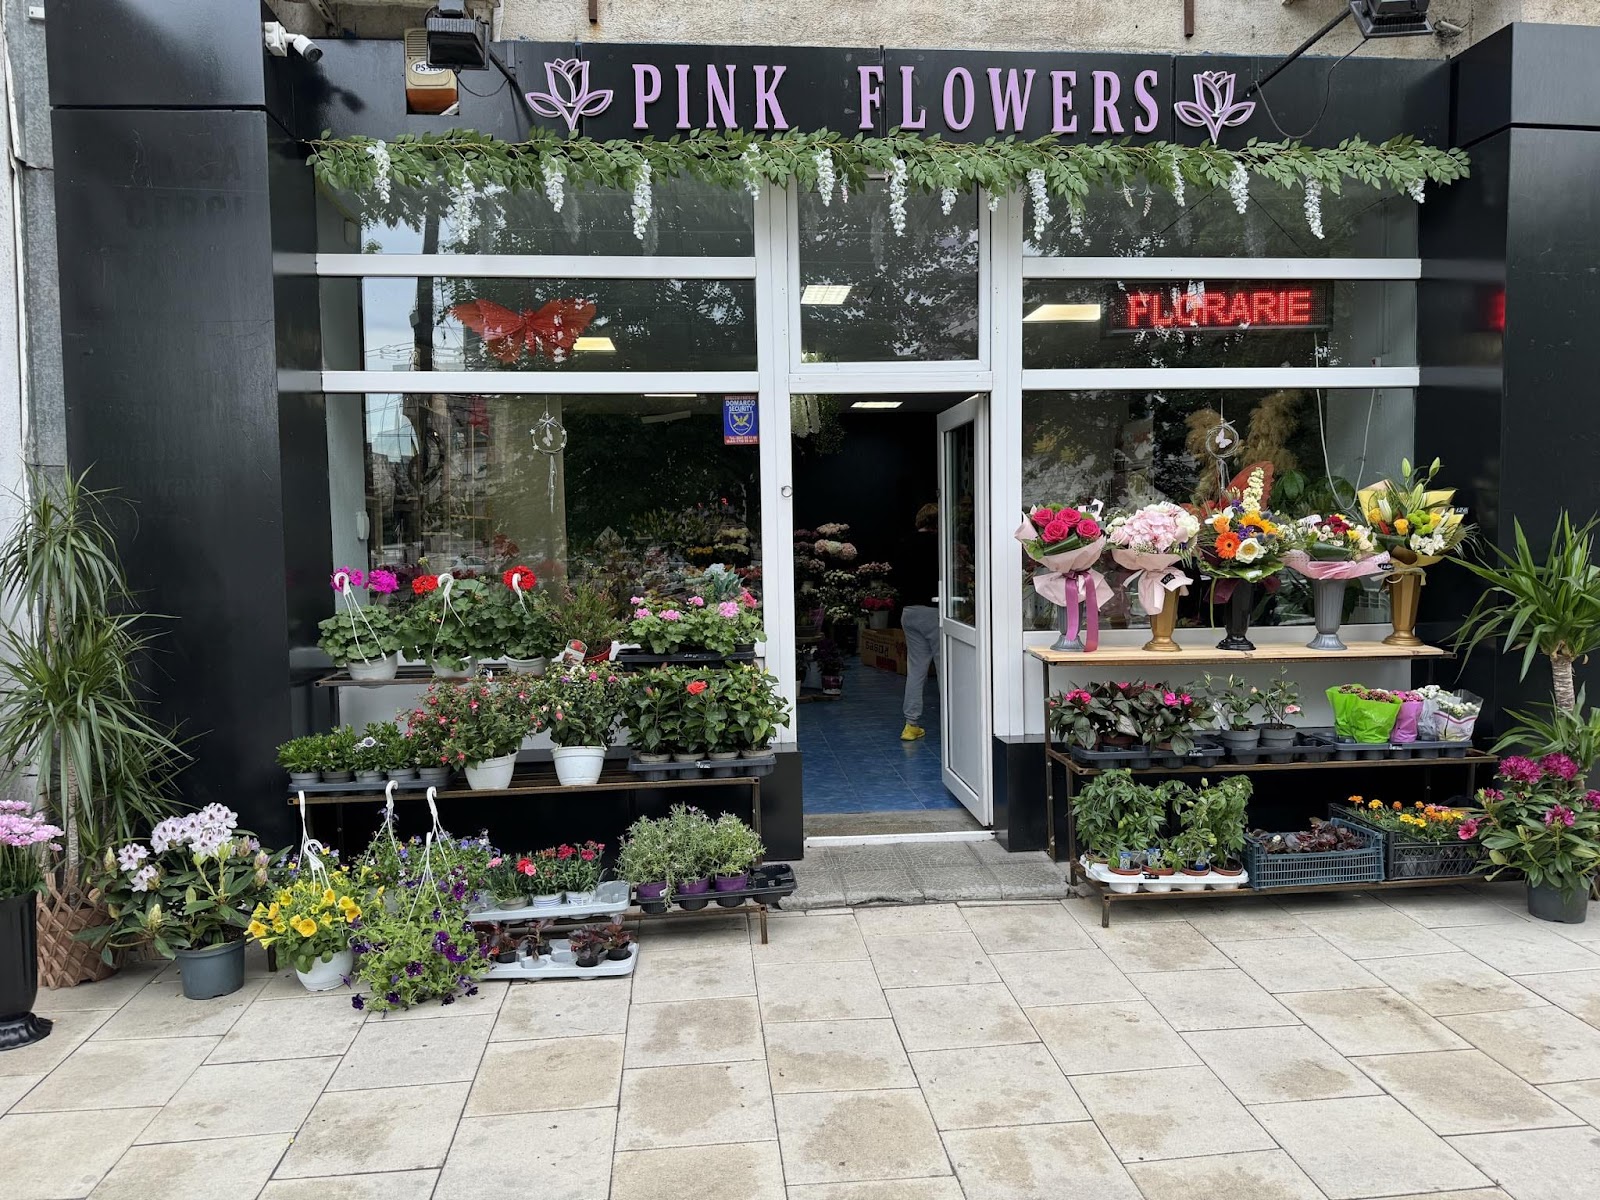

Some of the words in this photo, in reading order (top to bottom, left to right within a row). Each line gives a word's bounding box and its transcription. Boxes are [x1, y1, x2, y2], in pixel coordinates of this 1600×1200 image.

[632, 64, 789, 129] PINK
[857, 65, 1159, 134] FLOWERS
[1128, 289, 1312, 327] FLORARIE
